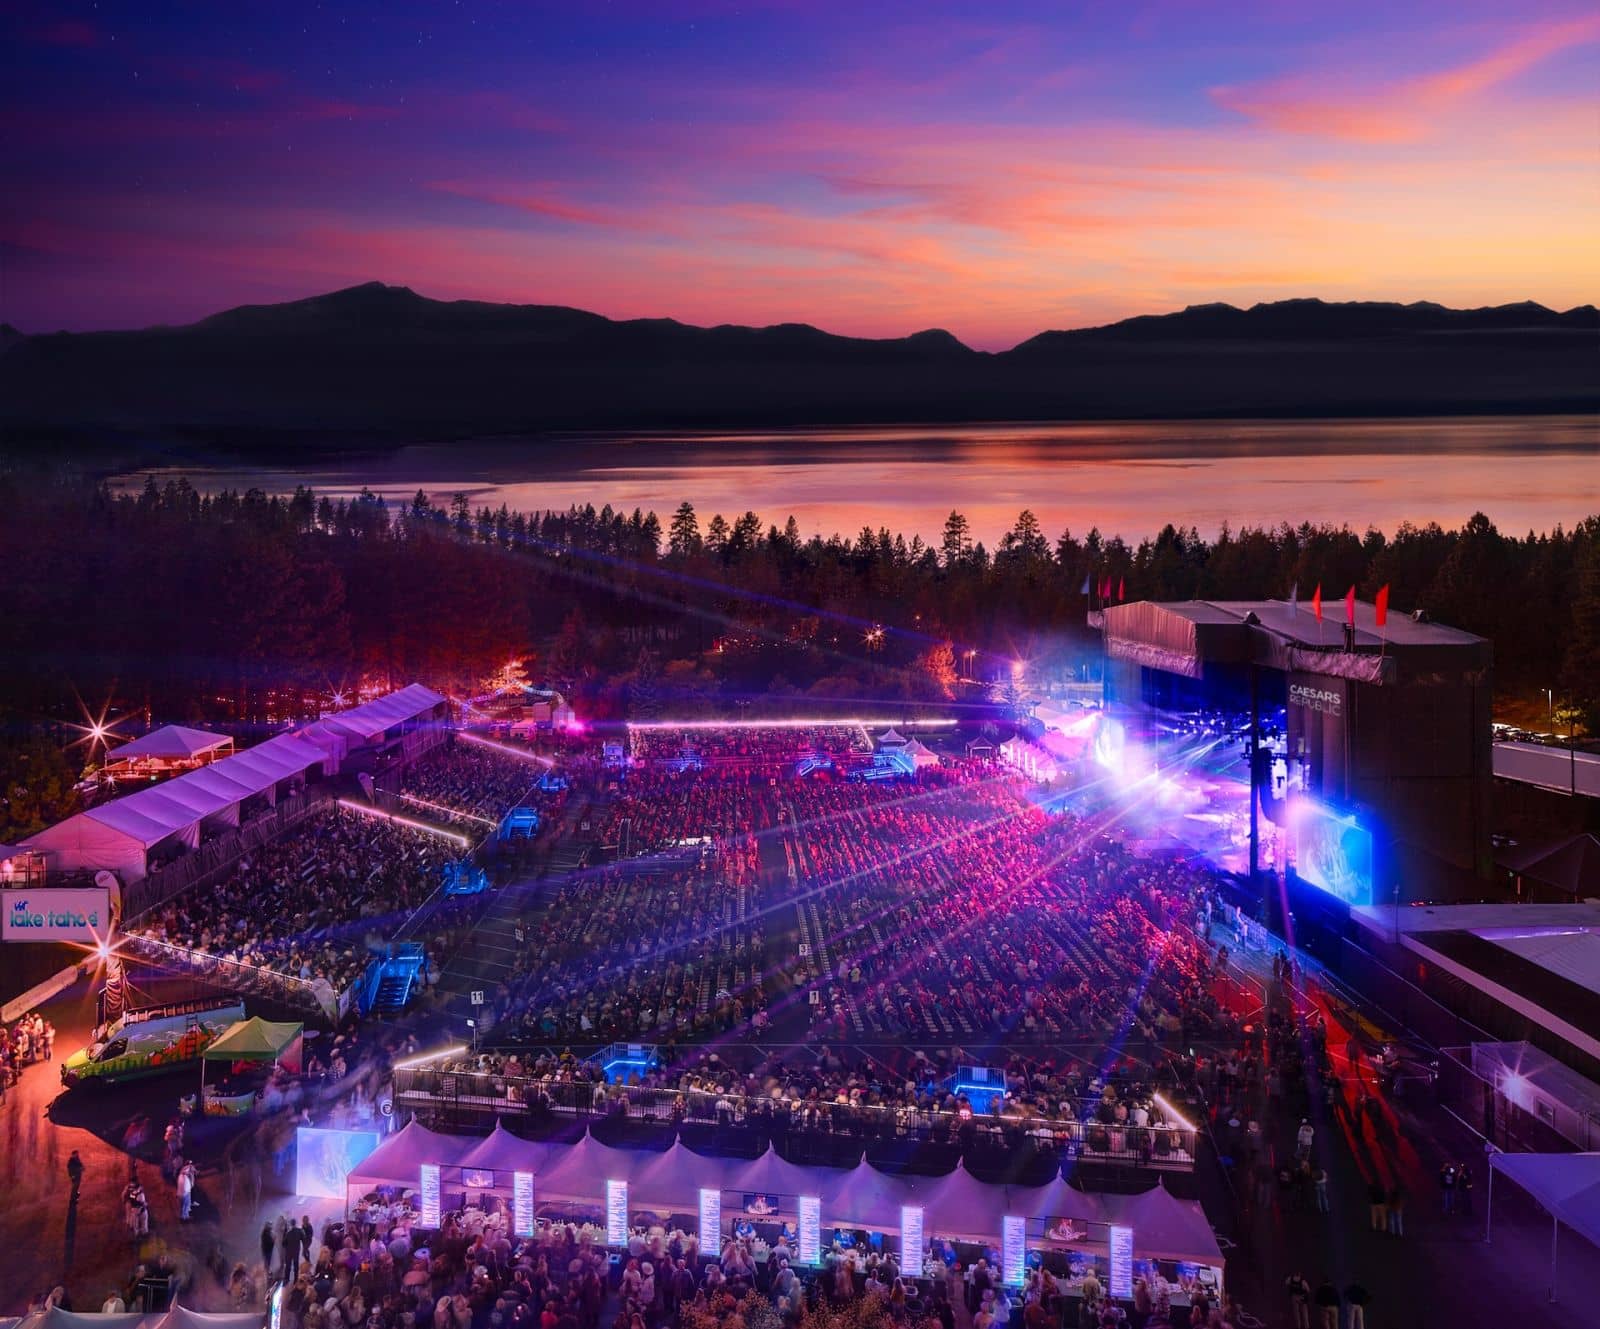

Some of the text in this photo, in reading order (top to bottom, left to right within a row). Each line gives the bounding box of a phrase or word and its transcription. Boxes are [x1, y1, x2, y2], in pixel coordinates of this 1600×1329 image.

[1290, 685, 1341, 704] CAESARS
[1290, 695, 1341, 716] REPUBLIC
[10, 911, 44, 927] lake
[472, 992, 483, 1001] 11
